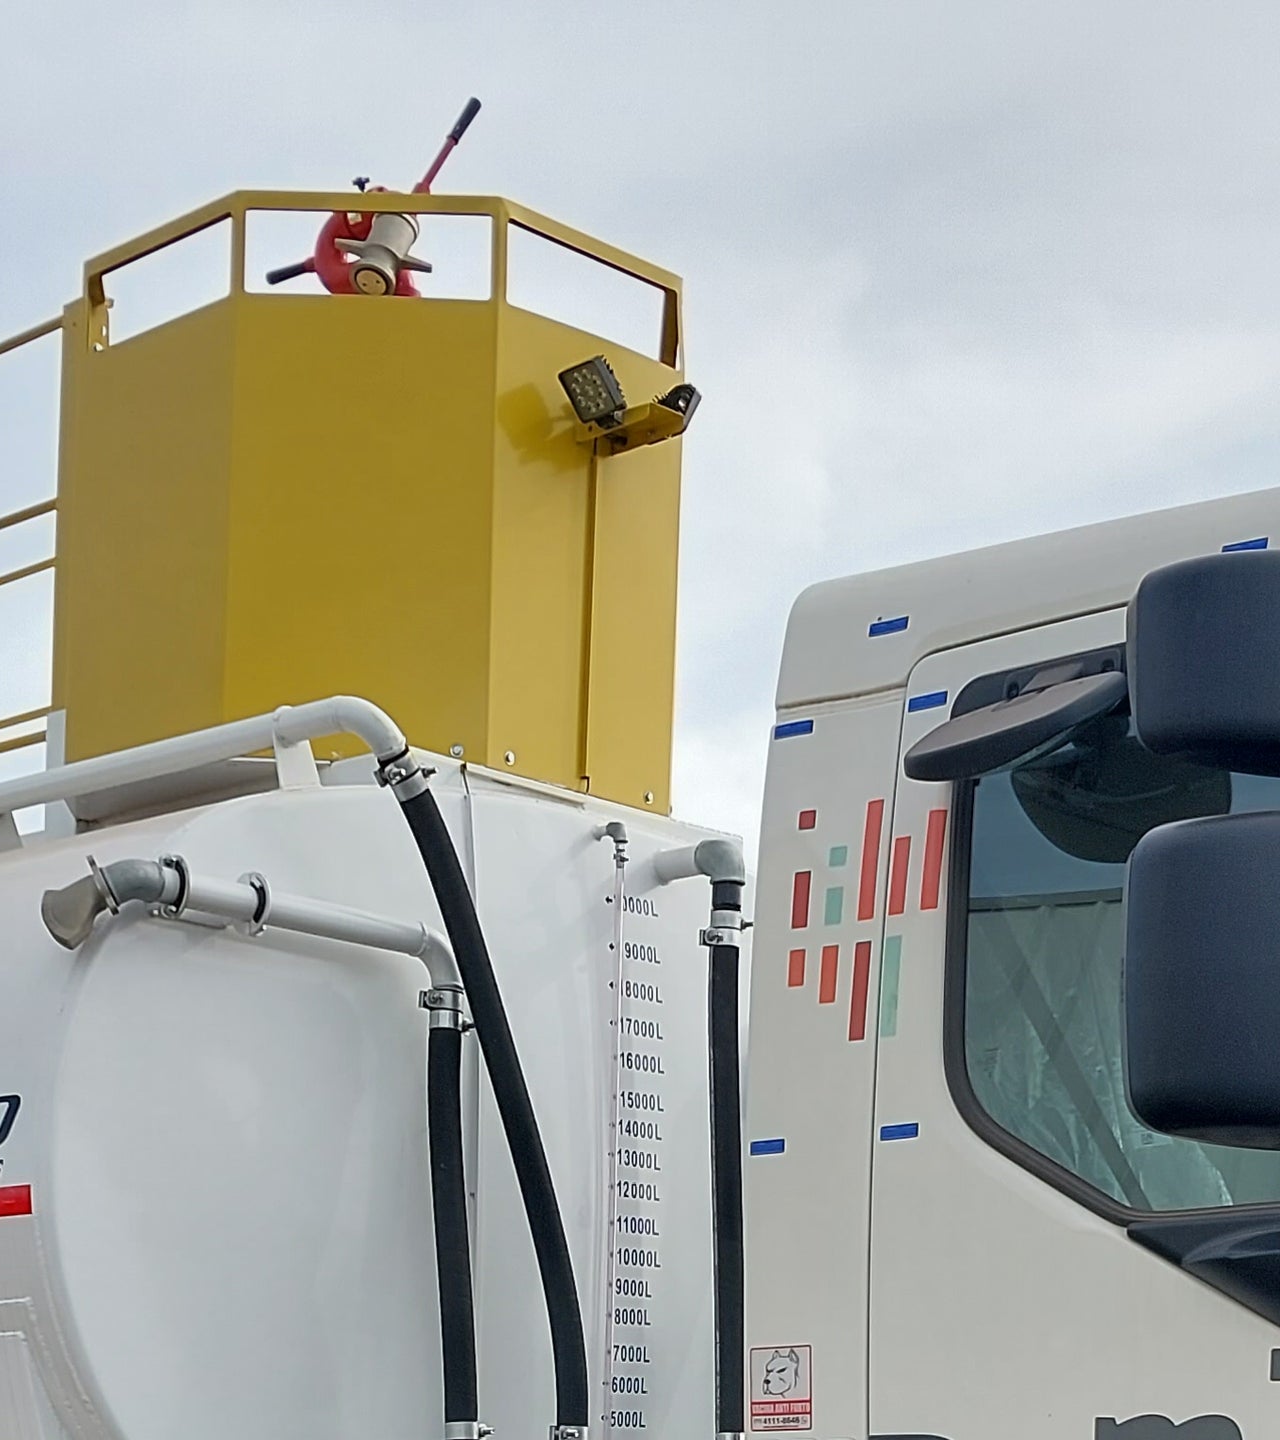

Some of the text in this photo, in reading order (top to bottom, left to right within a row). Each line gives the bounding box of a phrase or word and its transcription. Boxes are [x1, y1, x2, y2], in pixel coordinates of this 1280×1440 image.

[620, 1016, 664, 1040] 17000L
[620, 1051, 665, 1075] 16000L
[619, 1090, 665, 1113] 15000L
[618, 1118, 663, 1141] 14000L
[616, 1148, 662, 1172] 13000L
[616, 1180, 661, 1202] 12000L
[616, 1215, 660, 1236] 11000L
[616, 1247, 662, 1268] 10000L
[615, 1278, 652, 1299] 9000L
[613, 1307, 652, 1327] 8000L
[612, 1344, 651, 1364] 7000L
[610, 1376, 649, 1395] 6000L
[610, 1410, 647, 1429] 5000L
